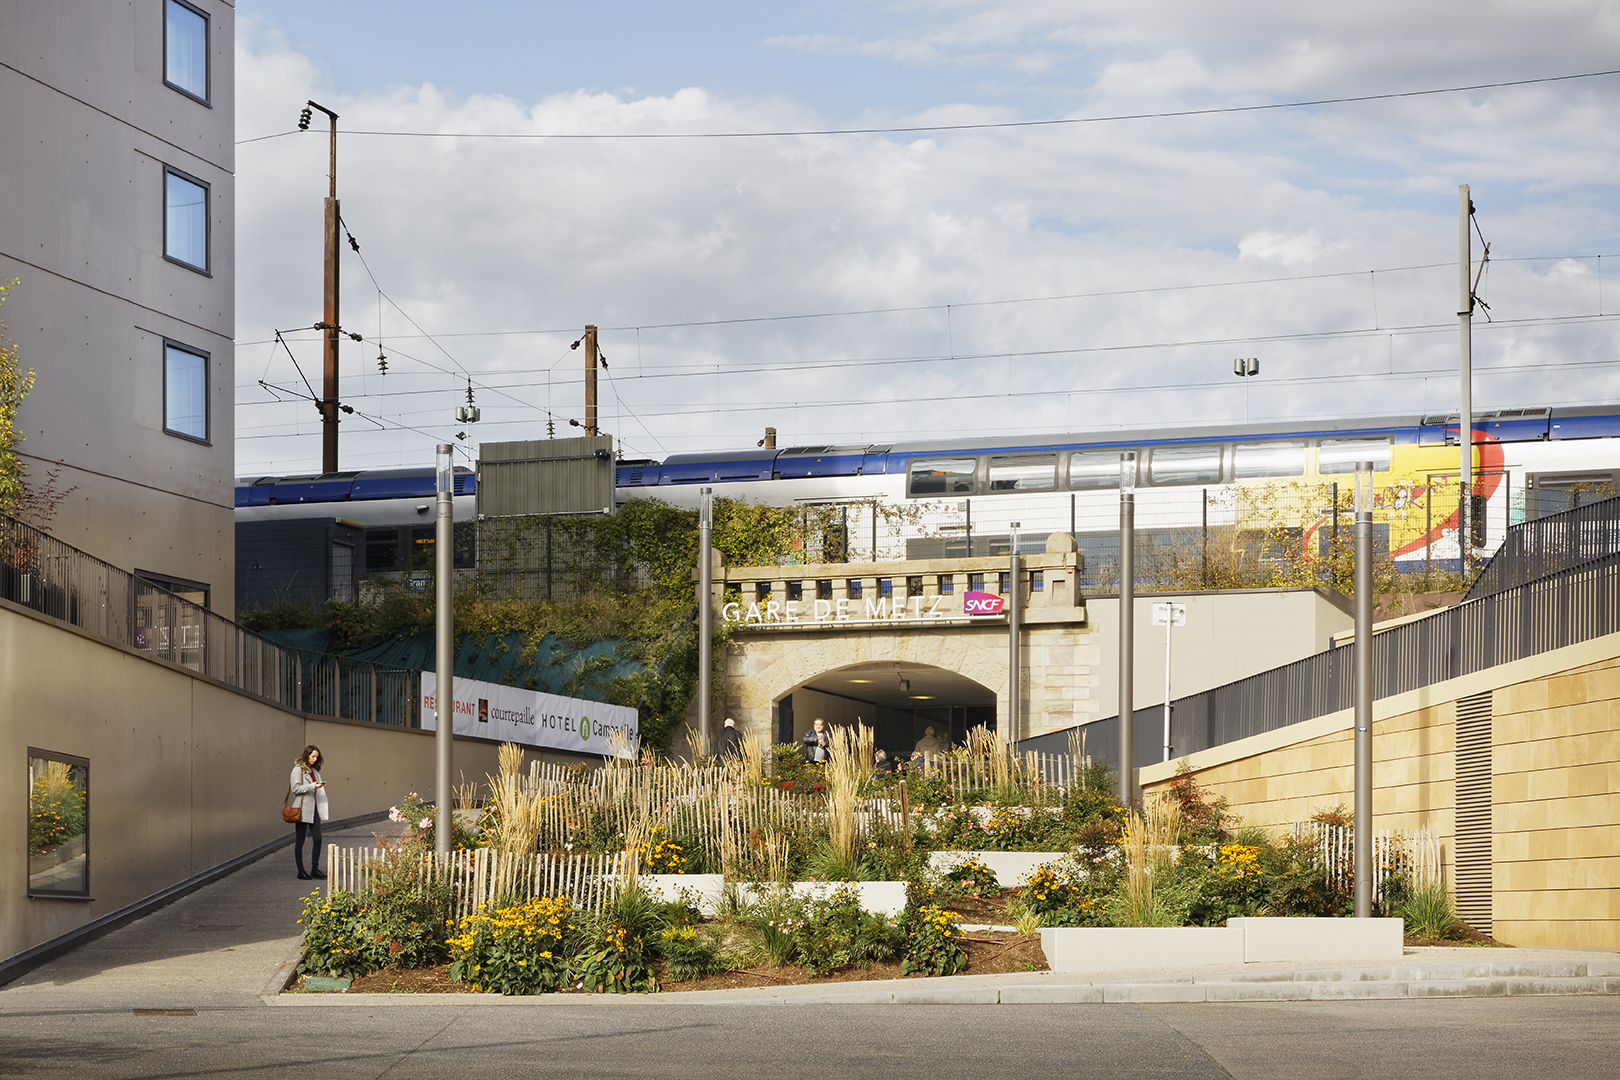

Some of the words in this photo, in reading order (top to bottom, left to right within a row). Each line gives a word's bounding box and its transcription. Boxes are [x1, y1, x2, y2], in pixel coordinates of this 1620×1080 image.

[722, 601, 799, 622] GARE
[814, 598, 850, 620] DE
[866, 595, 943, 618] METZ
[965, 599, 1001, 611] SNCF
[424, 696, 475, 716] REURANT
[491, 706, 535, 726] courtepaille
[541, 713, 577, 733] HOTEL
[592, 719, 634, 744] Camaile
